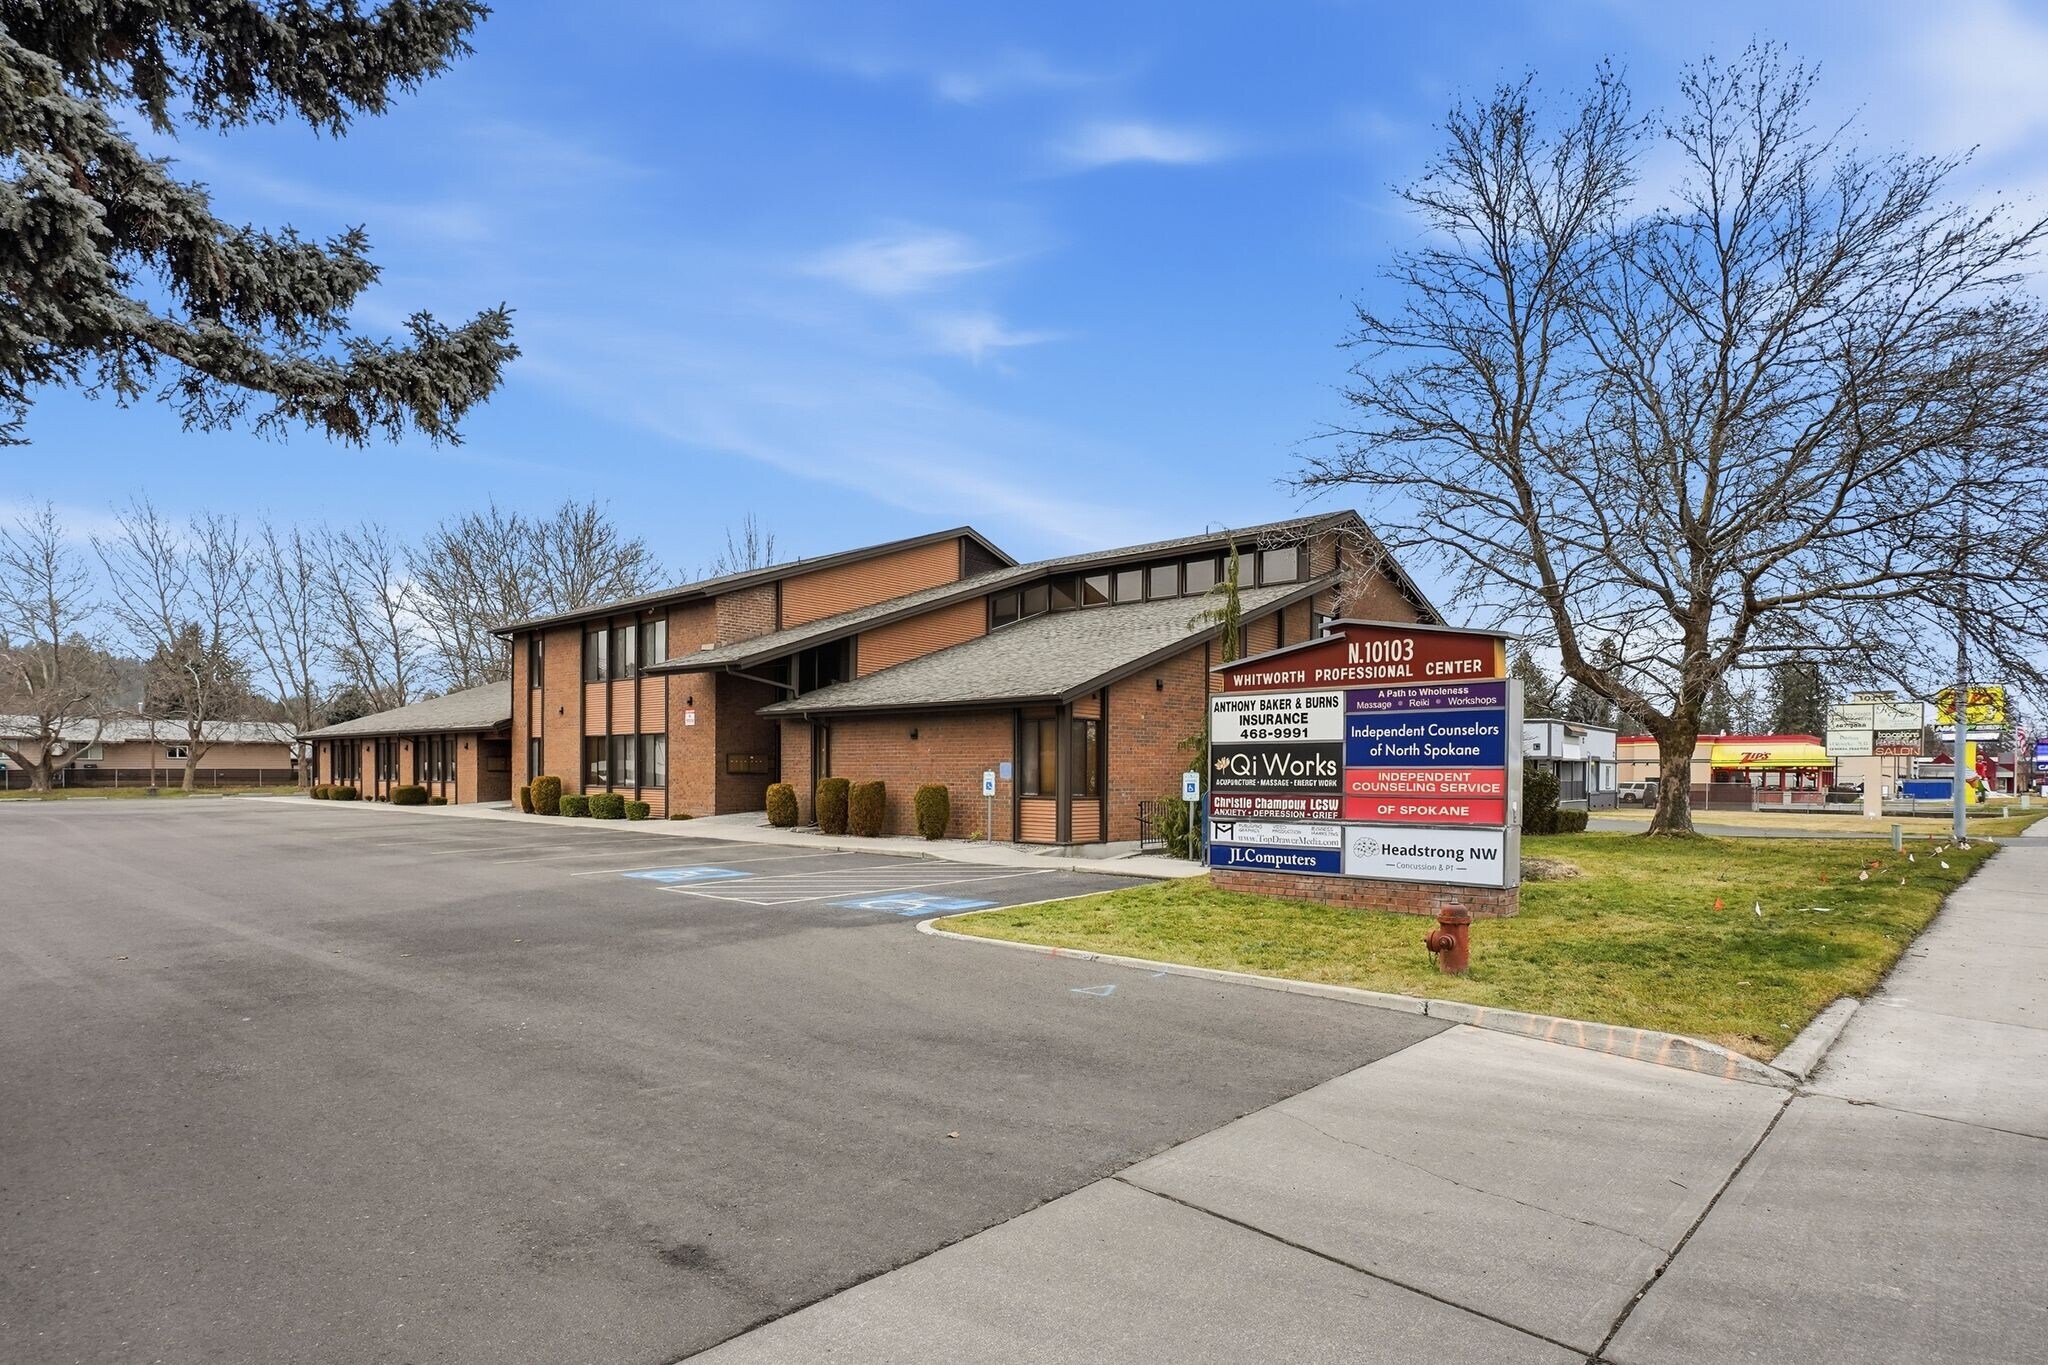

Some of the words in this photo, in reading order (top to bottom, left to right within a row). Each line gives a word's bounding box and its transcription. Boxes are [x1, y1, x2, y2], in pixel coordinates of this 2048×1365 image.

[1348, 639, 1415, 664] N.10103
[1233, 670, 1305, 687] WHITWORTH
[1315, 664, 1413, 682] PROFESSIONAL
[1425, 659, 1482, 676] CENTER
[1378, 690, 1385, 698] A
[1387, 689, 1406, 698] Path
[1408, 688, 1417, 697] to
[1419, 687, 1469, 696] Wholeness
[1213, 699, 1256, 713] ANTHONY
[1259, 698, 1293, 711] BAKER
[1295, 697, 1303, 710] &
[1305, 696, 1339, 709] BURNS
[1356, 701, 1392, 710] Massage
[1409, 698, 1430, 707] Reiki
[1448, 696, 1497, 706] Workshops
[1239, 712, 1309, 727] INSURANCE
[1240, 727, 1309, 740] 468-9991
[1351, 723, 1425, 740] Independent
[1428, 722, 1499, 737] Counselors
[1370, 743, 1383, 757] of
[1385, 742, 1420, 756] North
[1424, 742, 1480, 759] Spokane
[1875, 747, 1920, 756] SALON
[1230, 753, 1257, 777] Qi
[1262, 752, 1337, 777] Works
[1216, 778, 1256, 786] ACUPUNCTURE
[1260, 779, 1290, 787] MASSAGE
[1293, 779, 1317, 787] ENERGY
[1318, 779, 1337, 787] WORK
[1378, 772, 1471, 782] INDEPENDENT
[1352, 782, 1436, 793] COUNSELING
[1440, 783, 1500, 793] SERVICE
[1214, 796, 1252, 809] Christie
[1255, 797, 1306, 811] Champoux
[1310, 799, 1339, 811] LCSW
[1214, 808, 1247, 816] ANXIETY
[1253, 809, 1305, 818] DEPRESSION
[1312, 811, 1338, 819] GRIEF
[1377, 805, 1396, 815] OF
[1400, 806, 1470, 817] SPOKANE
[1237, 834, 1339, 847] www.TopDrawerMedia.com
[1228, 847, 1317, 868] JLComputers
[1381, 844, 1464, 862] Headstrong
[1470, 847, 1497, 860] NW
[1396, 861, 1437, 871] Concussion
[1445, 864, 1454, 872] PT
